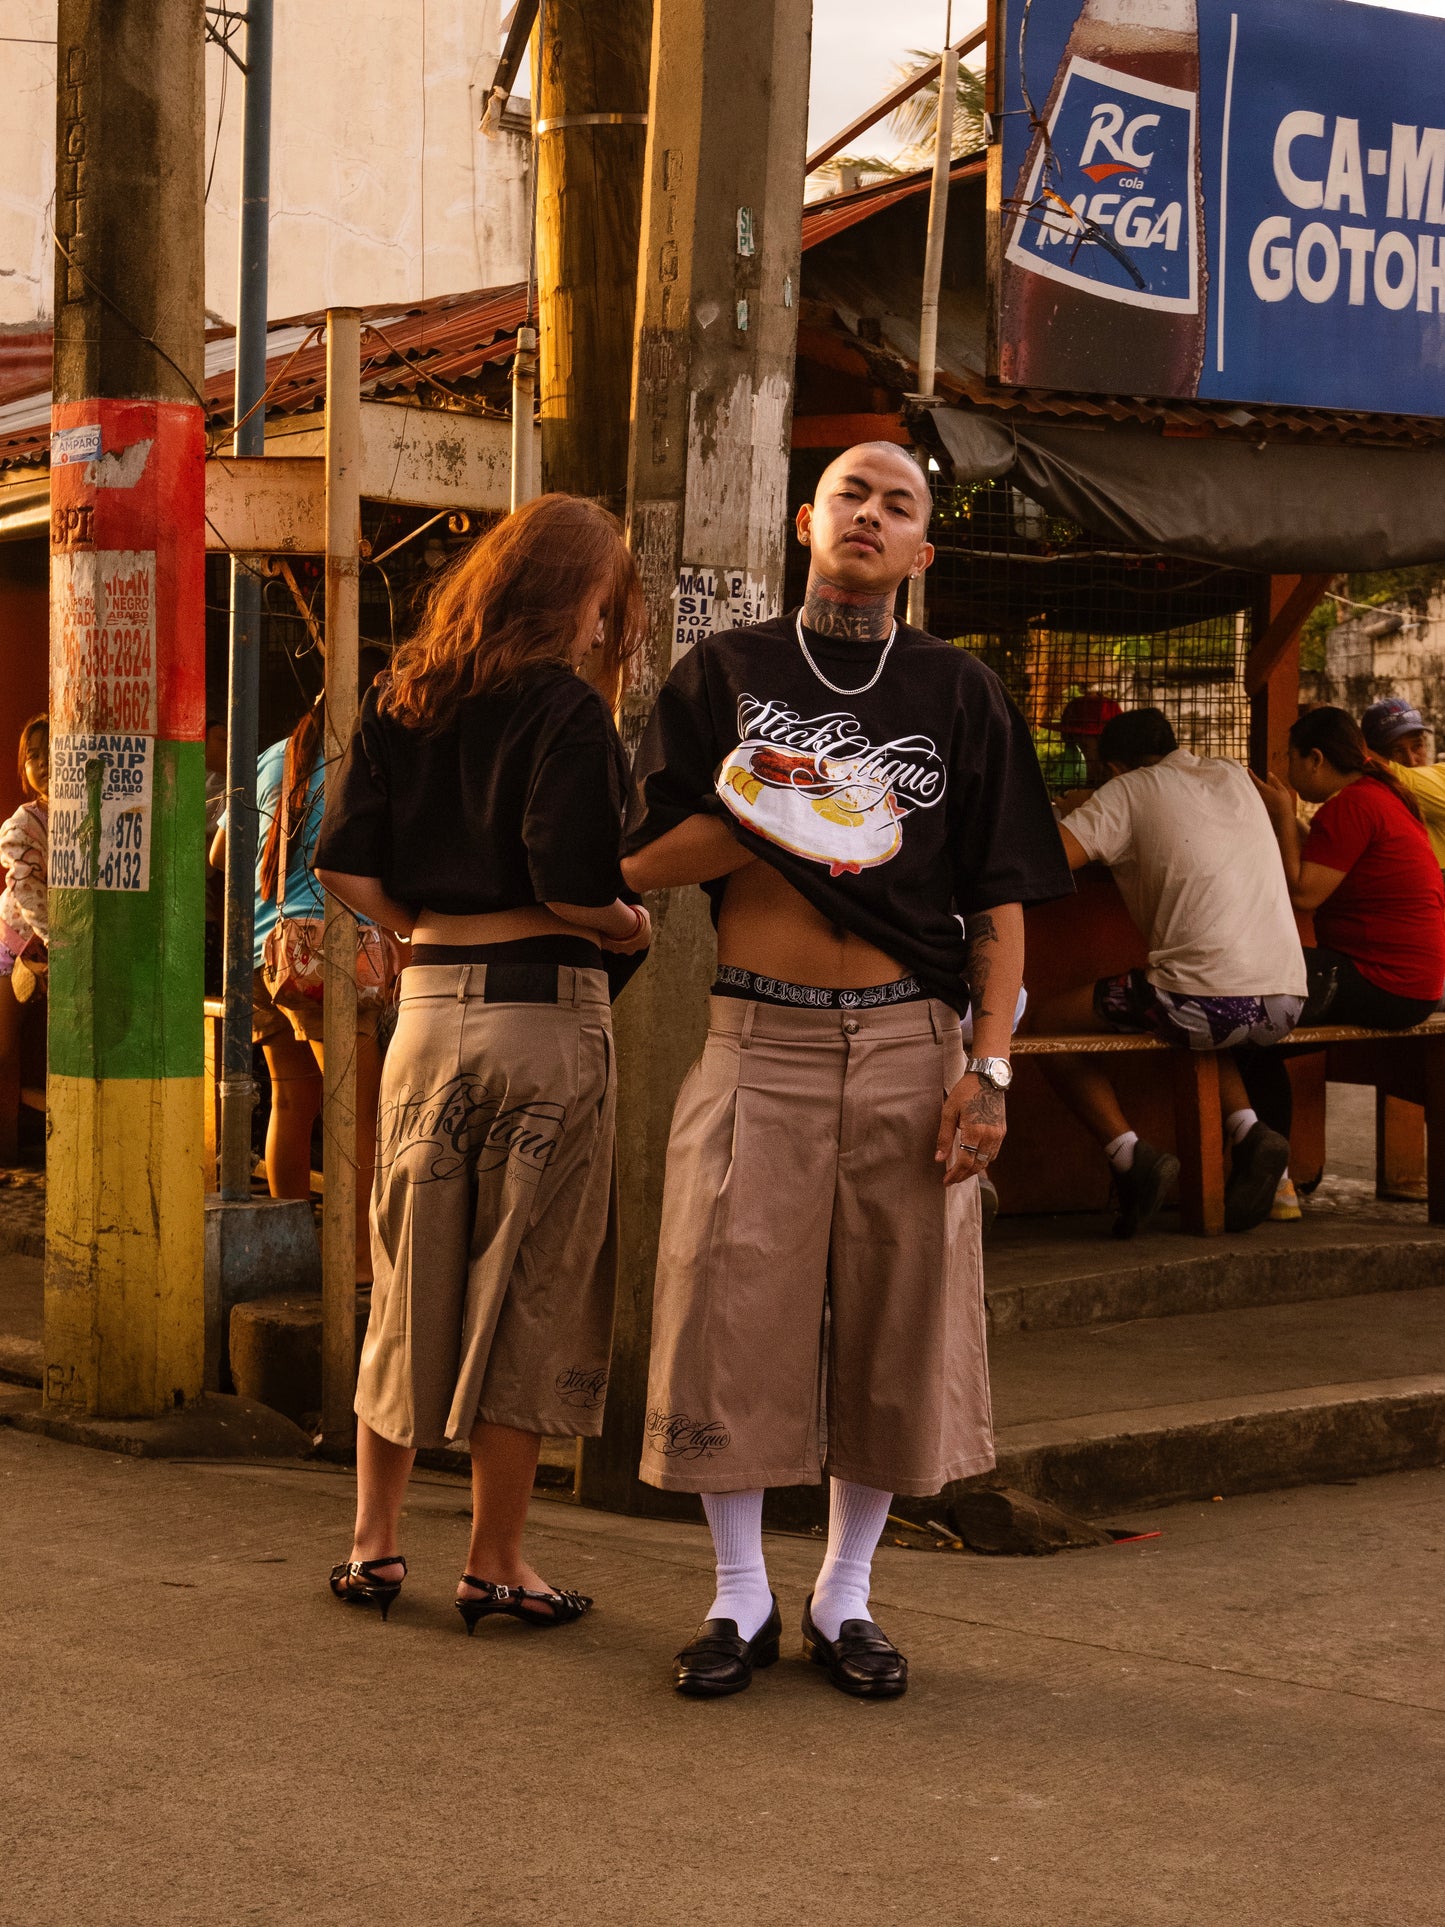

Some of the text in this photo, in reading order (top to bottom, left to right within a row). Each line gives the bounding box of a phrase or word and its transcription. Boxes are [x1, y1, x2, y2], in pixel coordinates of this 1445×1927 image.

[1079, 103, 1161, 168] RC
[1273, 110, 1445, 225] CA-M
[1119, 176, 1144, 190] cola
[1035, 193, 1182, 251] MEGA
[59, 436, 99, 451] AMPARO
[112, 597, 149, 611] NEGRO
[109, 611, 149, 619] ABABO
[55, 735, 146, 753] MALABANAN
[104, 783, 142, 793] ABABO
[753, 976, 833, 1007] CLIQUE
[861, 977, 920, 1007] SLICK
